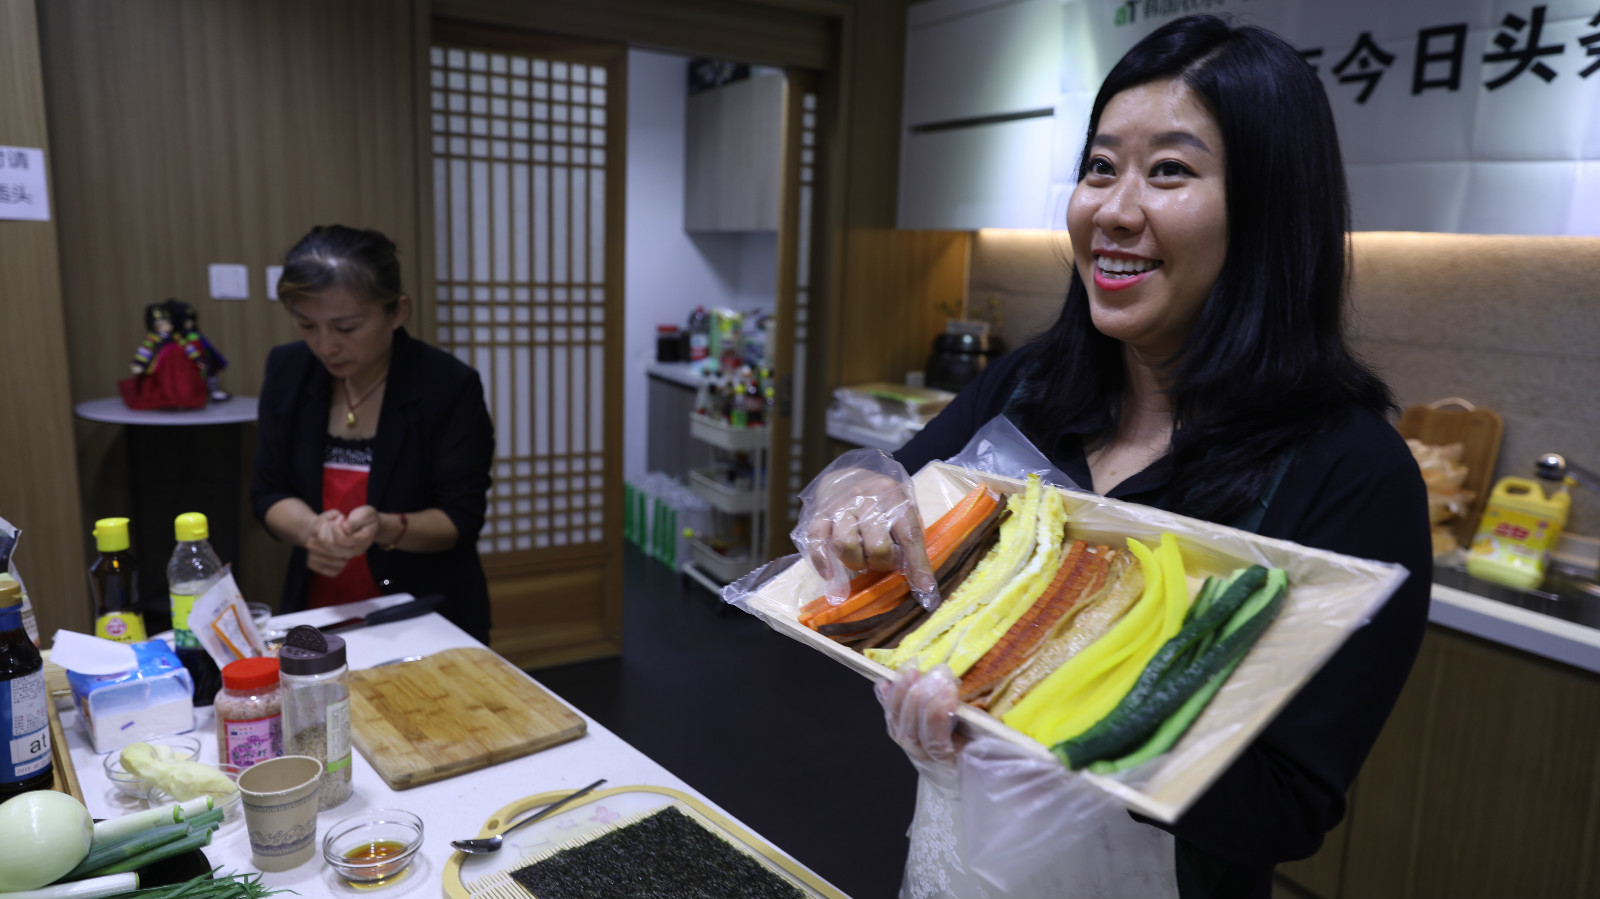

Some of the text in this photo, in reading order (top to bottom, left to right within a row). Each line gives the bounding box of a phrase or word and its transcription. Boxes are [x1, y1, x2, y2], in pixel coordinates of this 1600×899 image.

[1299, 6, 1600, 104] 今日头
[30, 733, 48, 755] at
